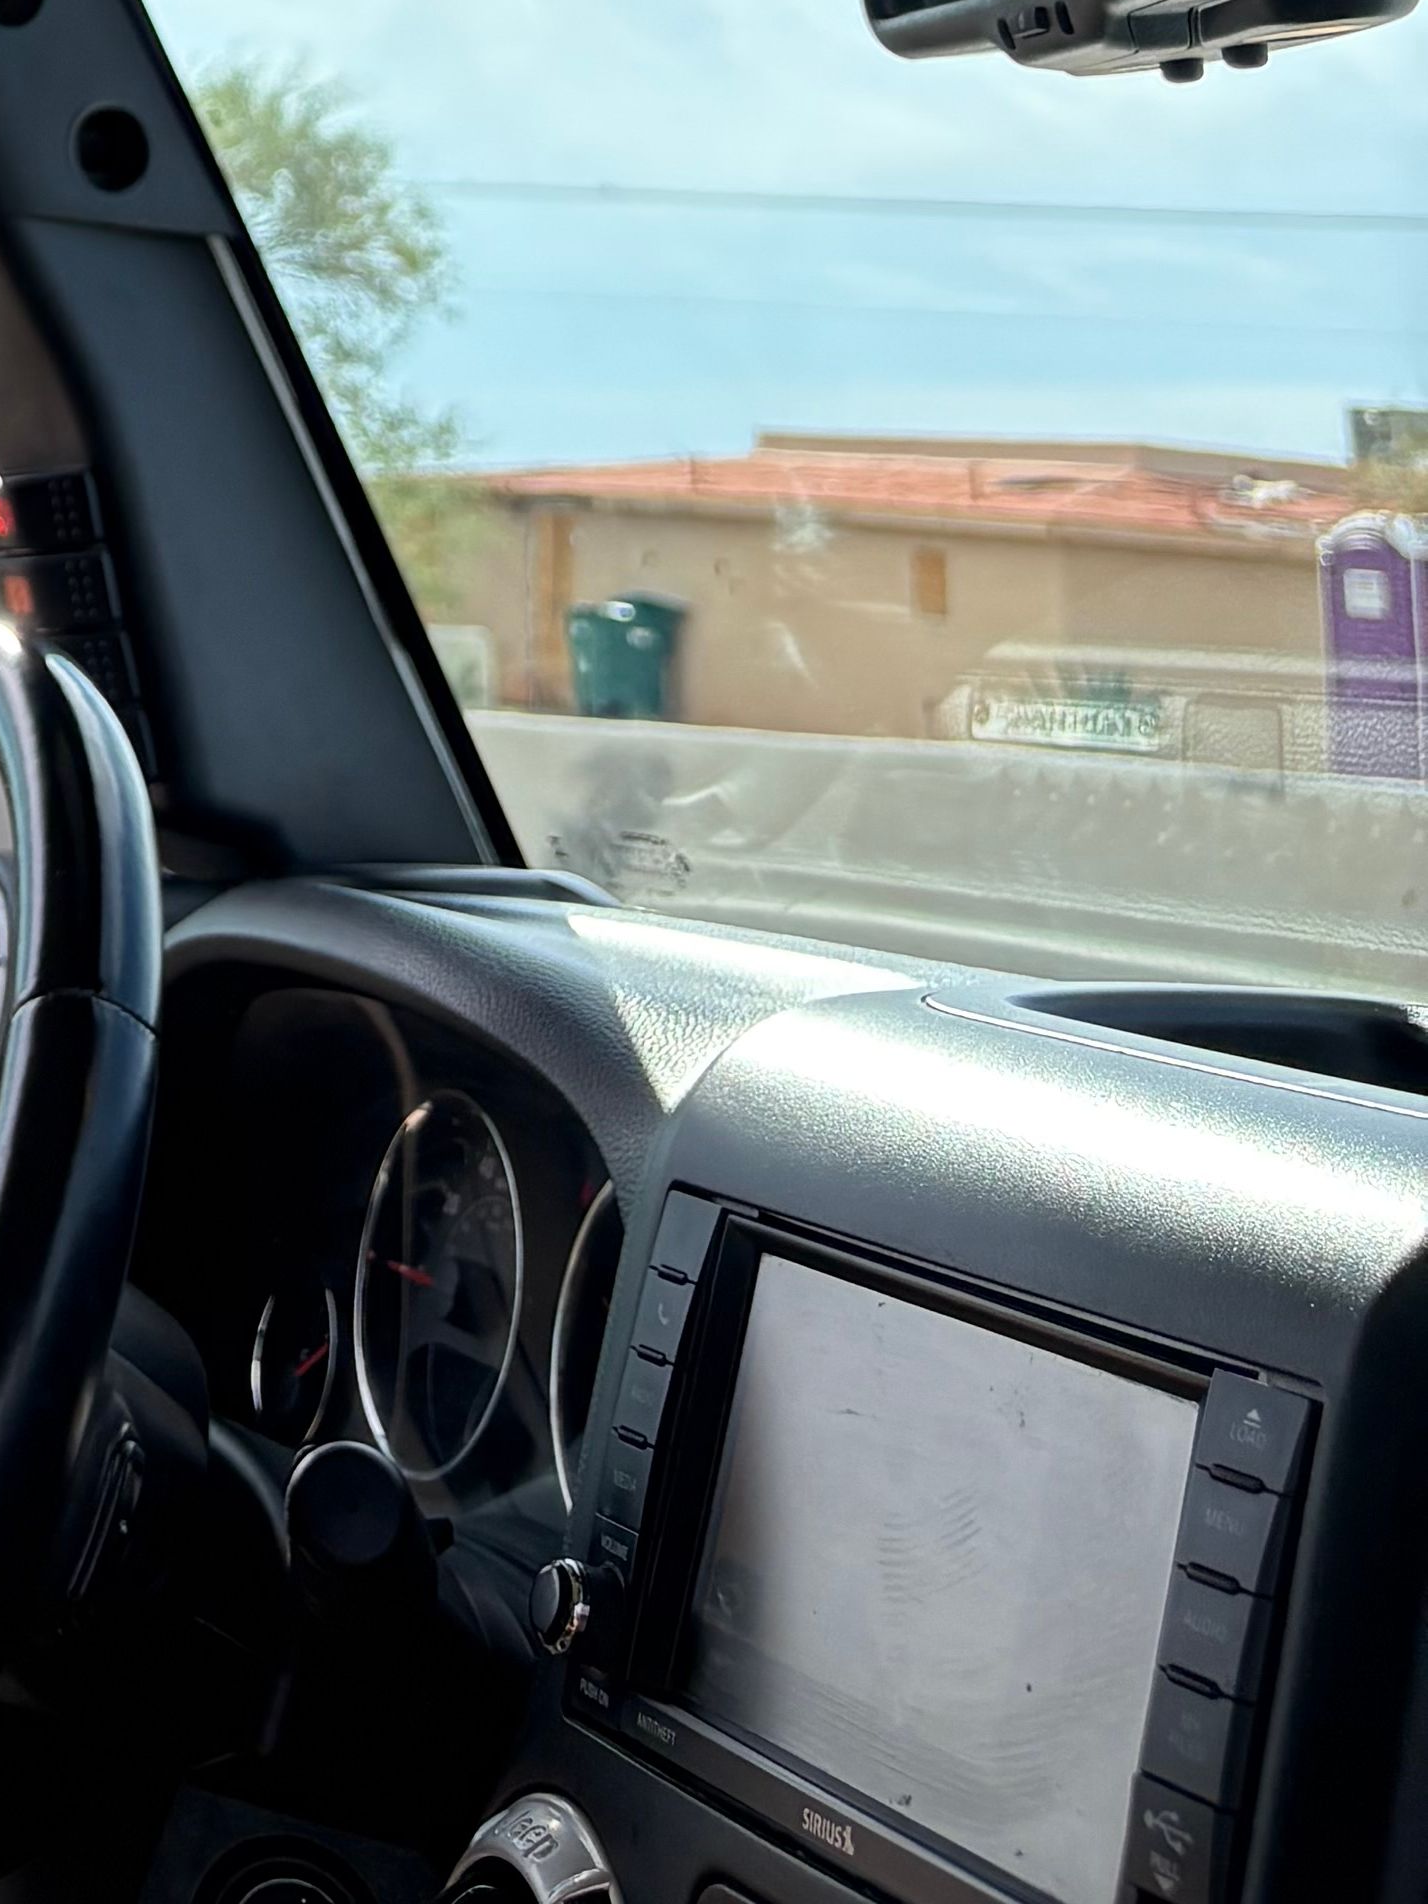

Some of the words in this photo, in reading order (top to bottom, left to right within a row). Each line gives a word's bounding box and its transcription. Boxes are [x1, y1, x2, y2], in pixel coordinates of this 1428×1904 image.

[1230, 1422, 1268, 1450] LOAD
[579, 1677, 598, 1703] PUSH
[637, 1712, 677, 1746] ANTITHEFT
[495, 1809, 559, 1862] Jeep
[801, 1807, 842, 1848] SIRIUS
